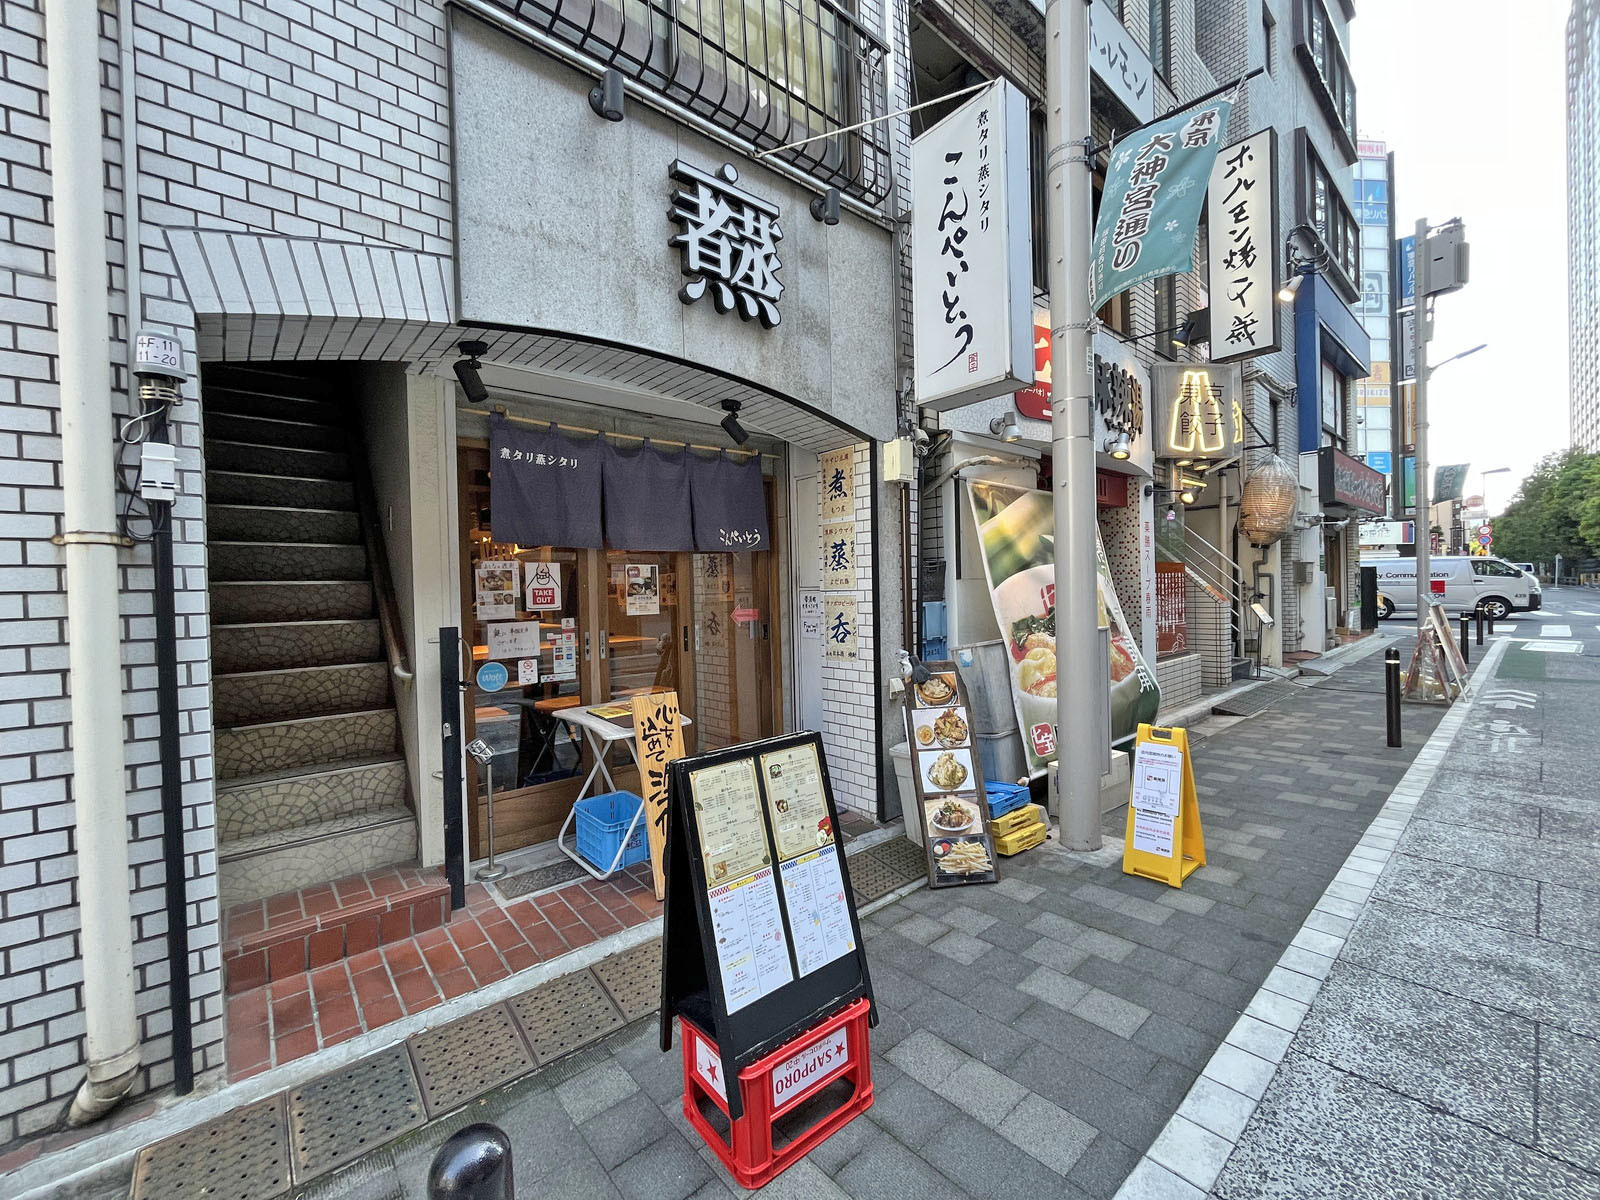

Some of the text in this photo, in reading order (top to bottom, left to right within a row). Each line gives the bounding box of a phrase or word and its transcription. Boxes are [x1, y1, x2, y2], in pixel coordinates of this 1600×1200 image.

[976, 109, 993, 234] 煮タリ蒸シタリ
[1112, 132, 1174, 271] 大神宮通り
[926, 151, 977, 376] こんぺいとう
[1179, 381, 1225, 406] 東京
[1179, 410, 1226, 436] 餃子
[499, 446, 579, 470] 煮タリ蒸シタリ
[826, 467, 848, 502] 煮
[718, 527, 761, 549] こんぺいとう
[828, 538, 850, 572] 蒸
[534, 589, 553, 597] TAKE
[829, 611, 852, 644] 呑
[775, 1048, 833, 1095] SAPPORO
